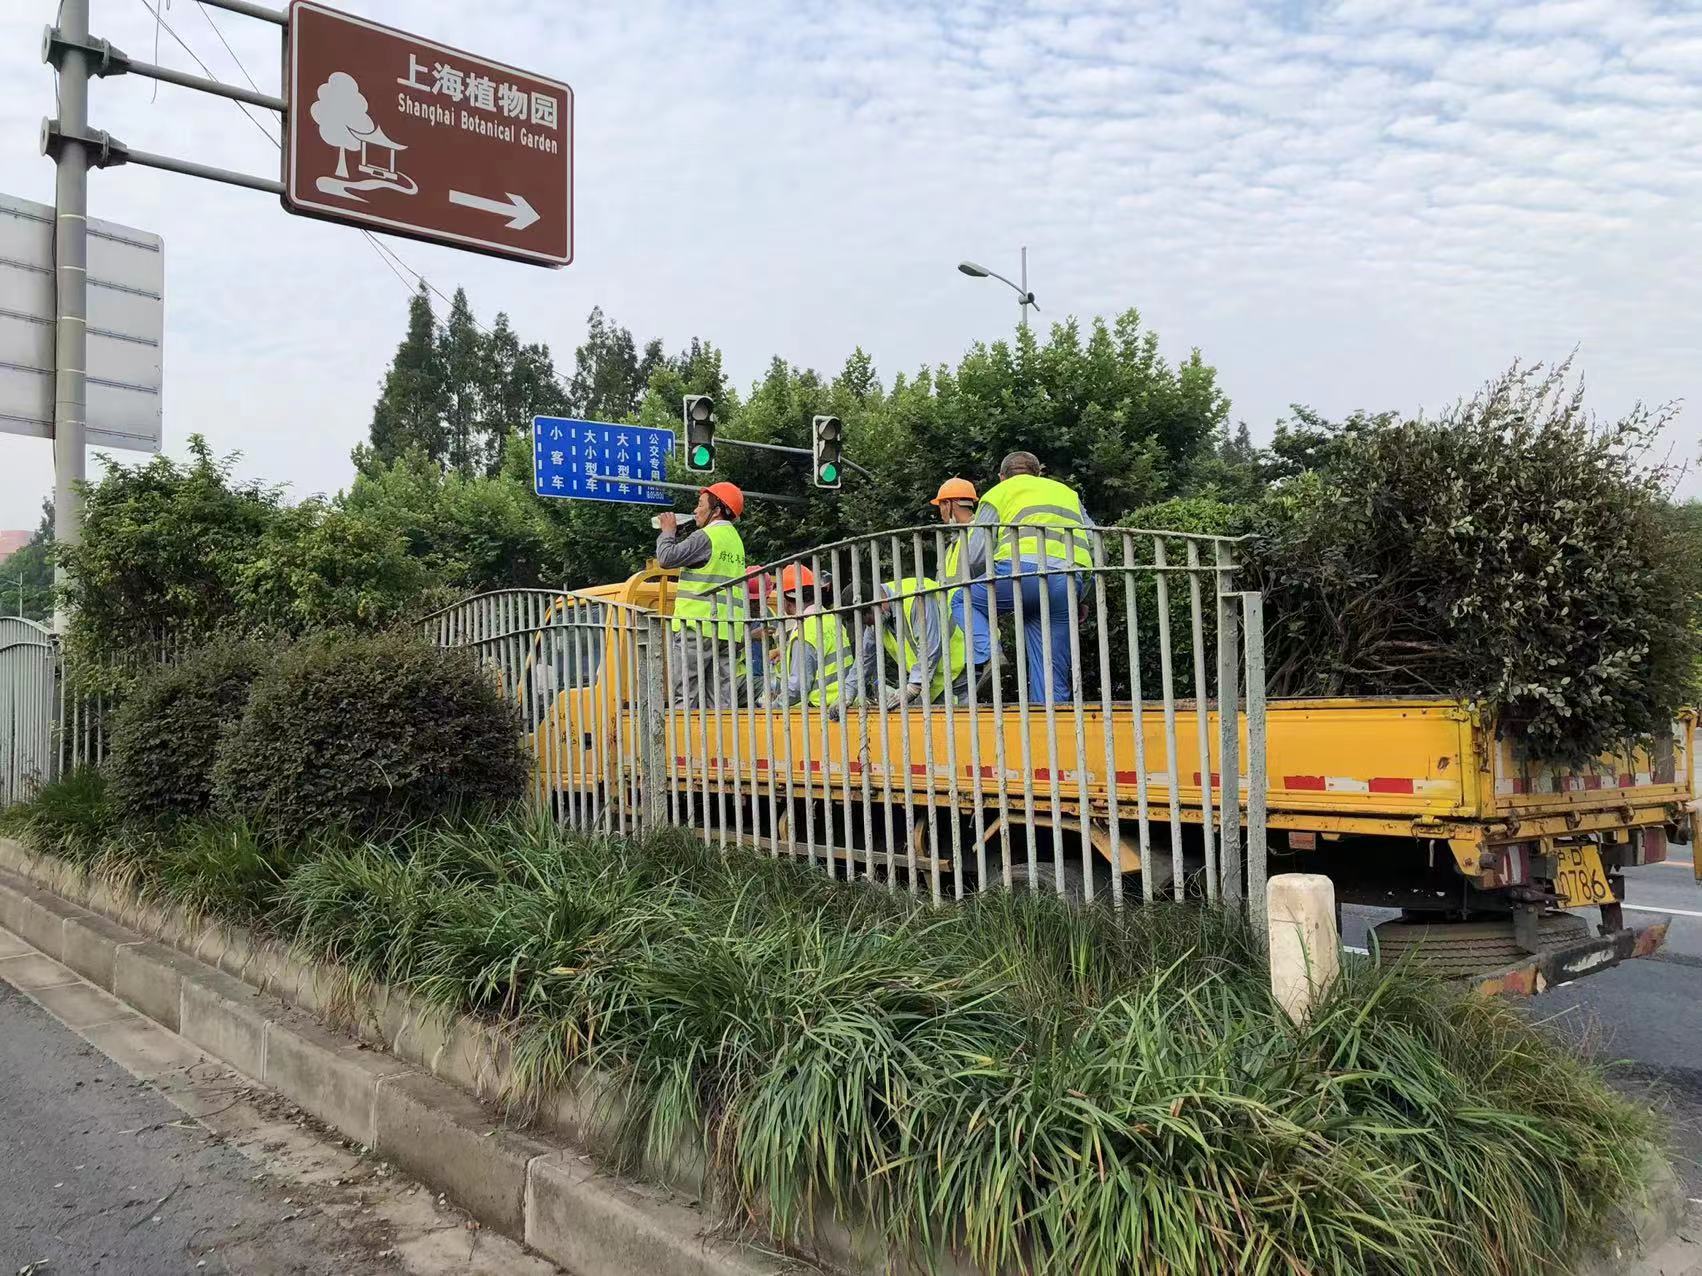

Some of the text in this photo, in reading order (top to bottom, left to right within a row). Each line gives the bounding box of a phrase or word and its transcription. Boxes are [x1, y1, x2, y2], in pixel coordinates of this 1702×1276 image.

[397, 53, 558, 130] 上海植物园
[397, 92, 558, 155] Shanghai Botanical Garden
[550, 425, 565, 490] 小客车
[584, 429, 599, 493] 大小型车
[616, 432, 631, 495] 大小型车
[1559, 868, 1606, 902] 0786
